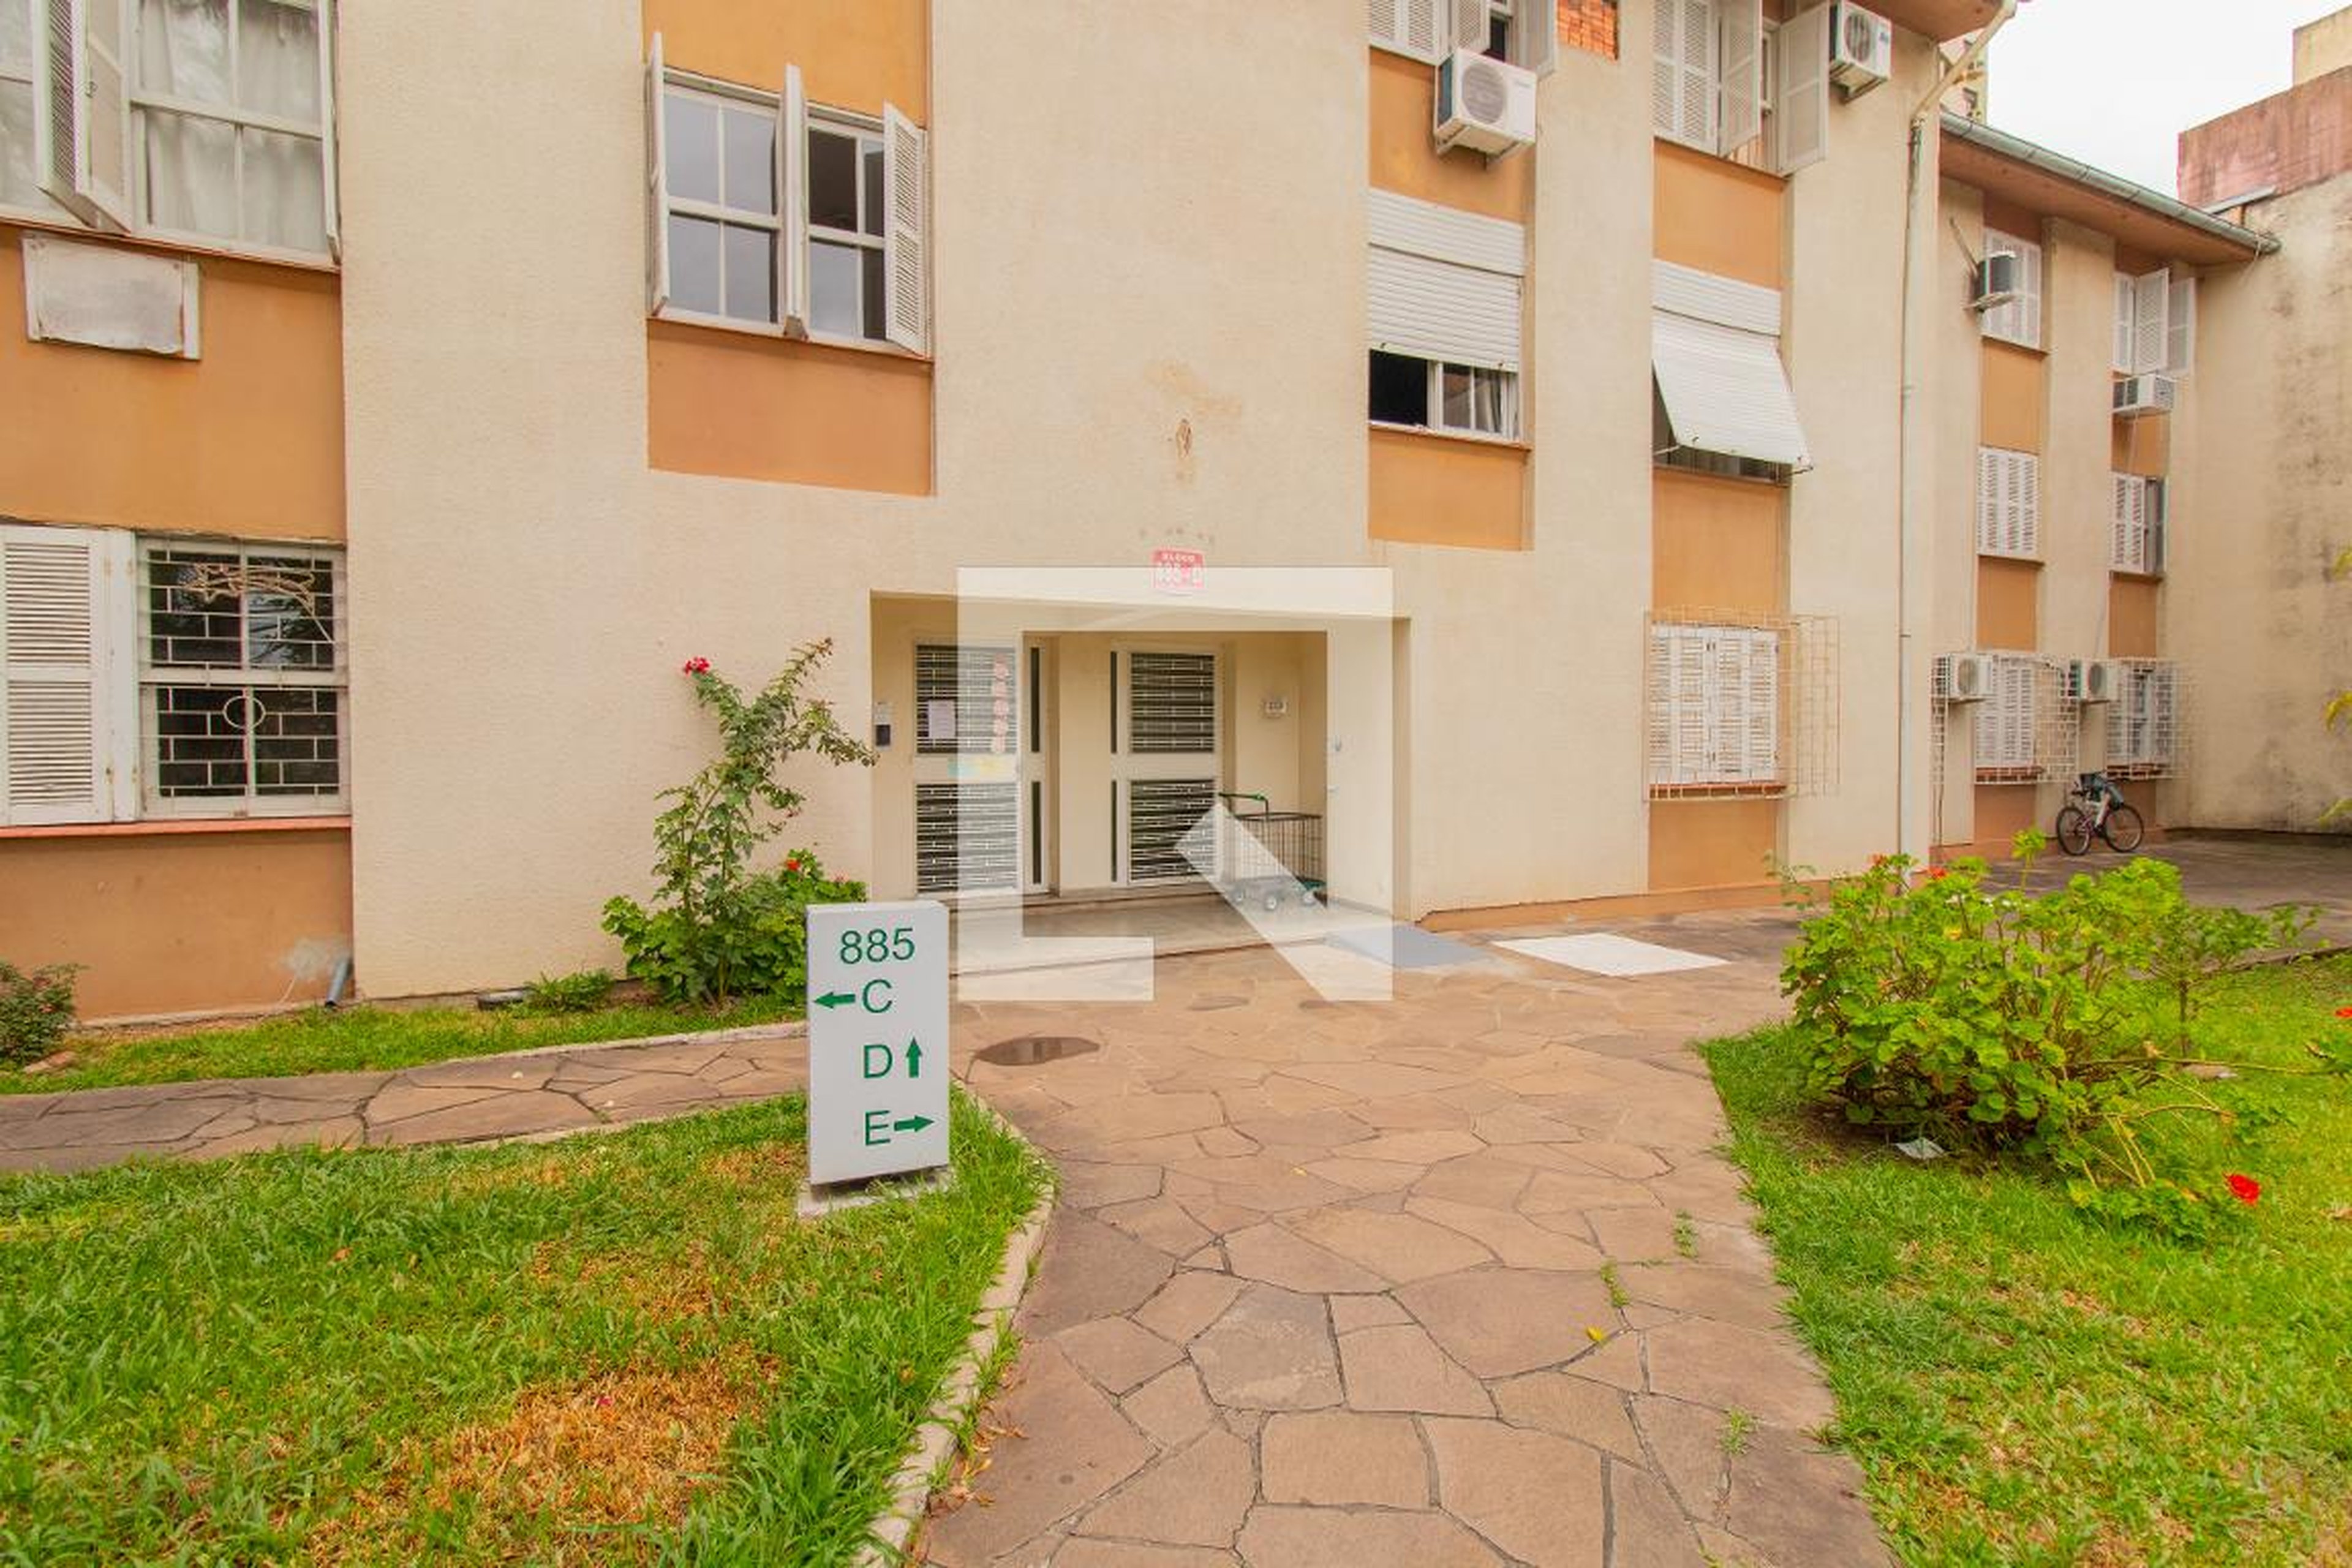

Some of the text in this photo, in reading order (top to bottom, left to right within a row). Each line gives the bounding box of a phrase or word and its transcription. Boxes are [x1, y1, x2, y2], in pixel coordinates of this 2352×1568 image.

[840, 927, 915, 964] 885
[862, 979, 892, 1014] C
[863, 1044, 893, 1079] D
[865, 1110, 891, 1146] E
